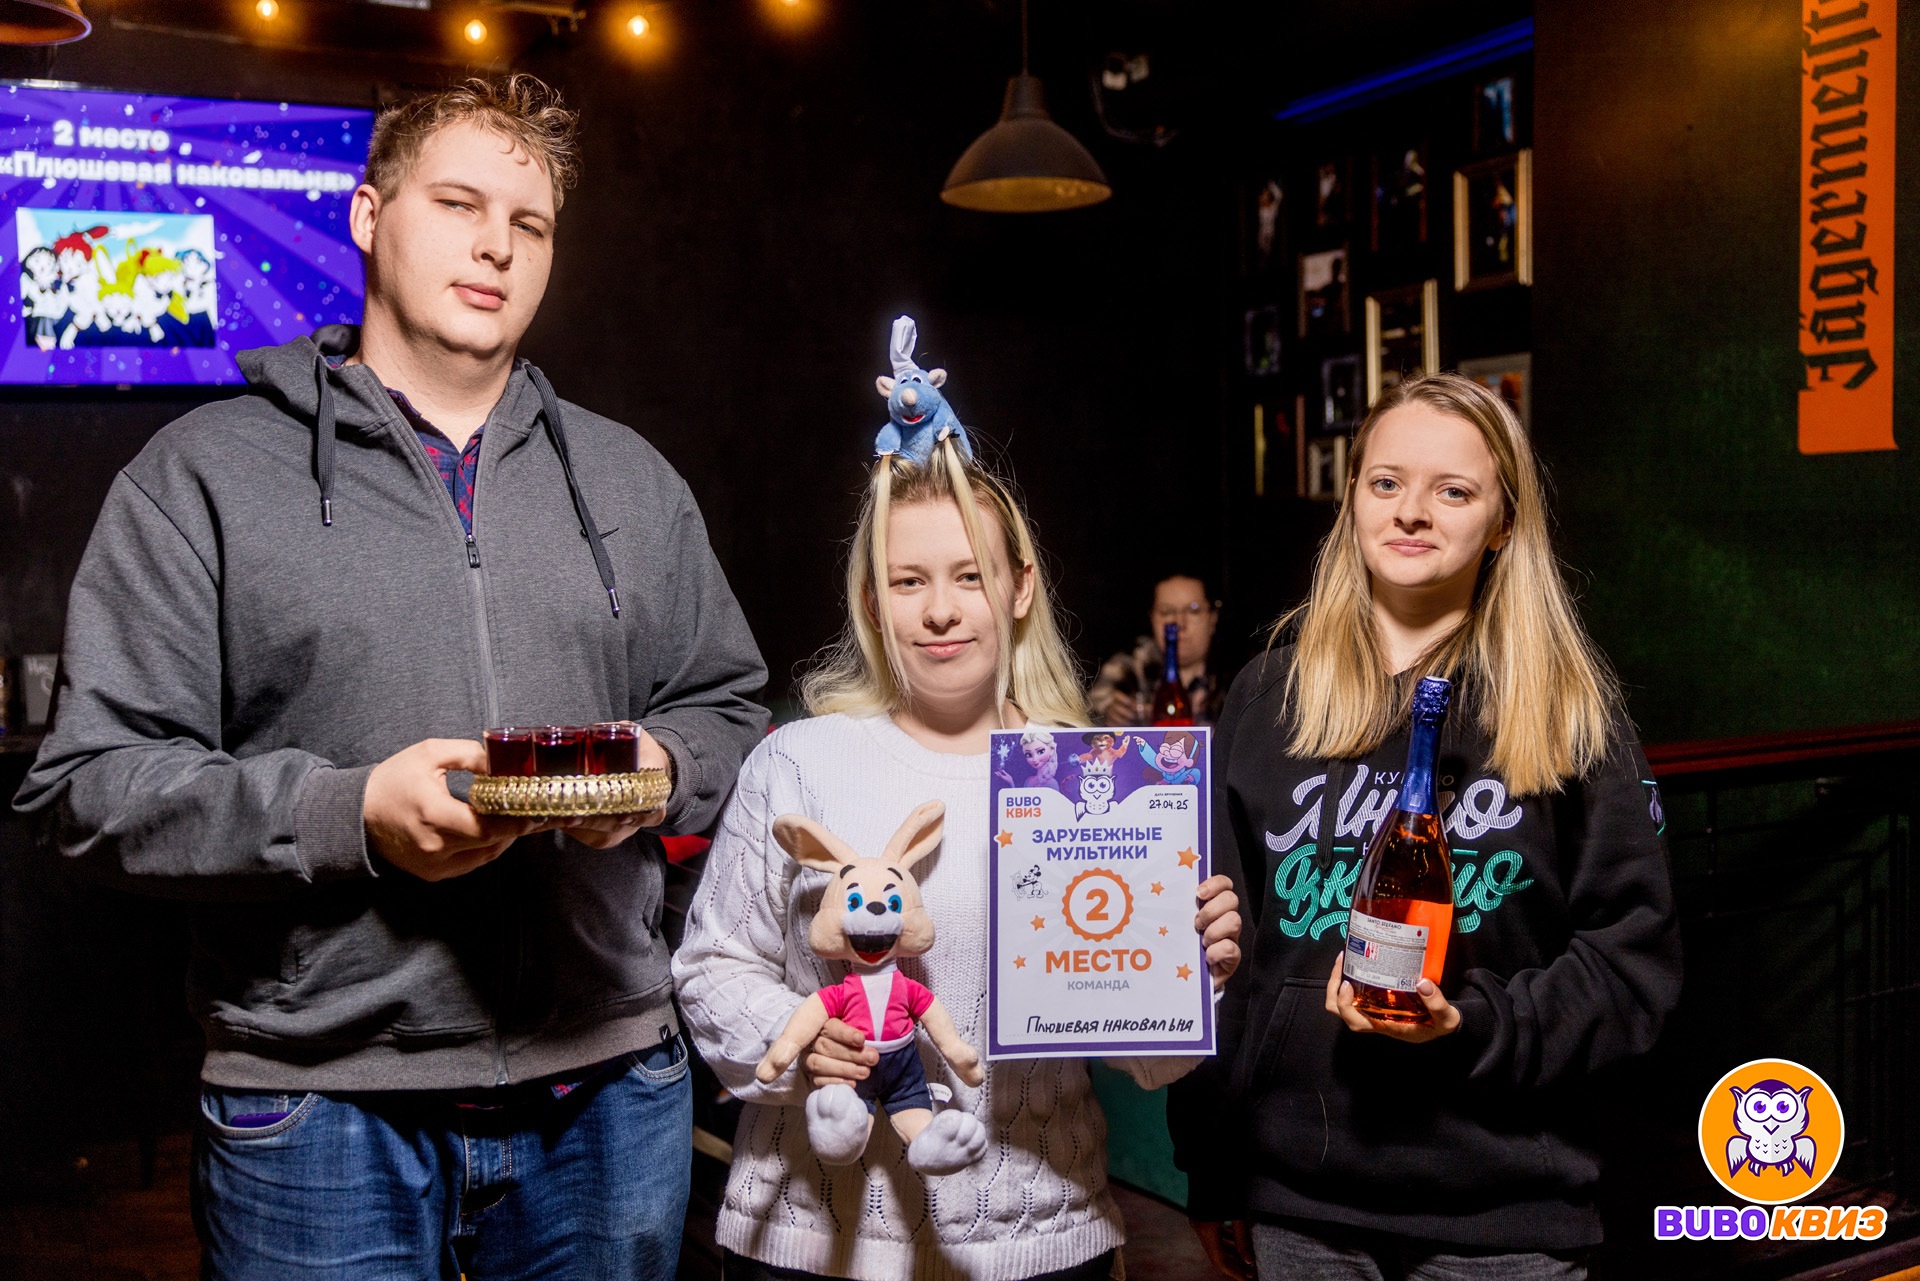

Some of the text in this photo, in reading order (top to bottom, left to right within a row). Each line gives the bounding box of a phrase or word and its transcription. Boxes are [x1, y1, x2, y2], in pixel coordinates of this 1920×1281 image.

[53, 120, 170, 152] 2 место
[176, 162, 356, 192] наковальня»
[1799, 0, 1881, 390] Jägermeist
[1006, 797, 1041, 807] BUBO
[1149, 799, 1189, 810] 27.04.25
[1006, 808, 1042, 818] КВИЗ
[1032, 827, 1163, 844] ЗАРУБЕЖНЫЕ
[1046, 845, 1148, 862] МУЛЬТИКИ
[1085, 888, 1109, 921] 2
[1045, 948, 1153, 974] МЕСТО
[1067, 979, 1130, 991] КОМАНДА
